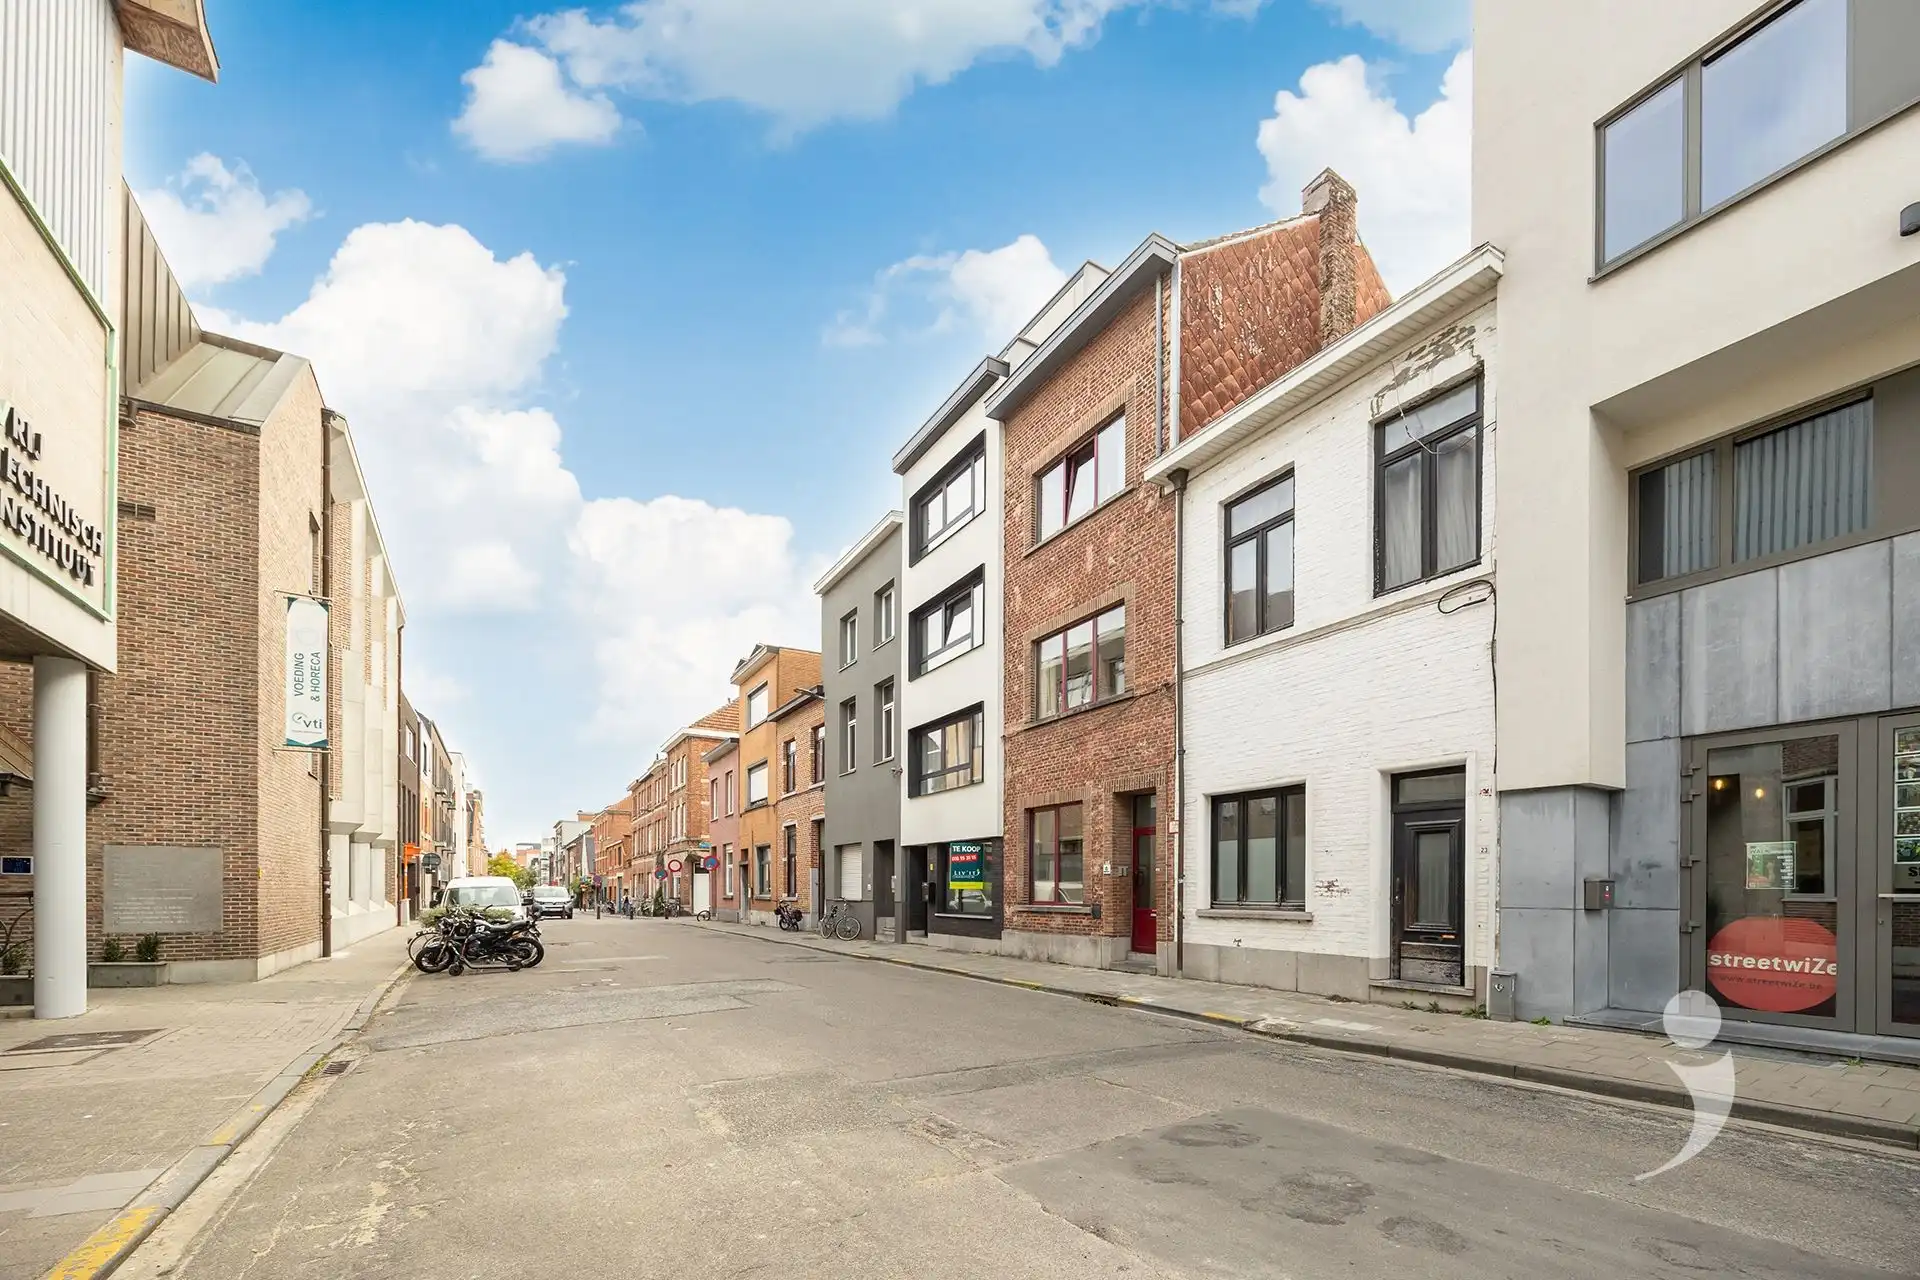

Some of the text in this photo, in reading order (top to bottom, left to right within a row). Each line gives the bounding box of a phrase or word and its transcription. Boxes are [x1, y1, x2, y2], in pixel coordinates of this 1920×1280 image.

[1, 447, 104, 556] ECHNISCH
[294, 653, 304, 696] VOEDING
[311, 652, 320, 692] HORECA
[303, 719, 322, 729] vti
[952, 845, 981, 853] TE KOOP
[1710, 953, 1837, 976] streetwiZe
